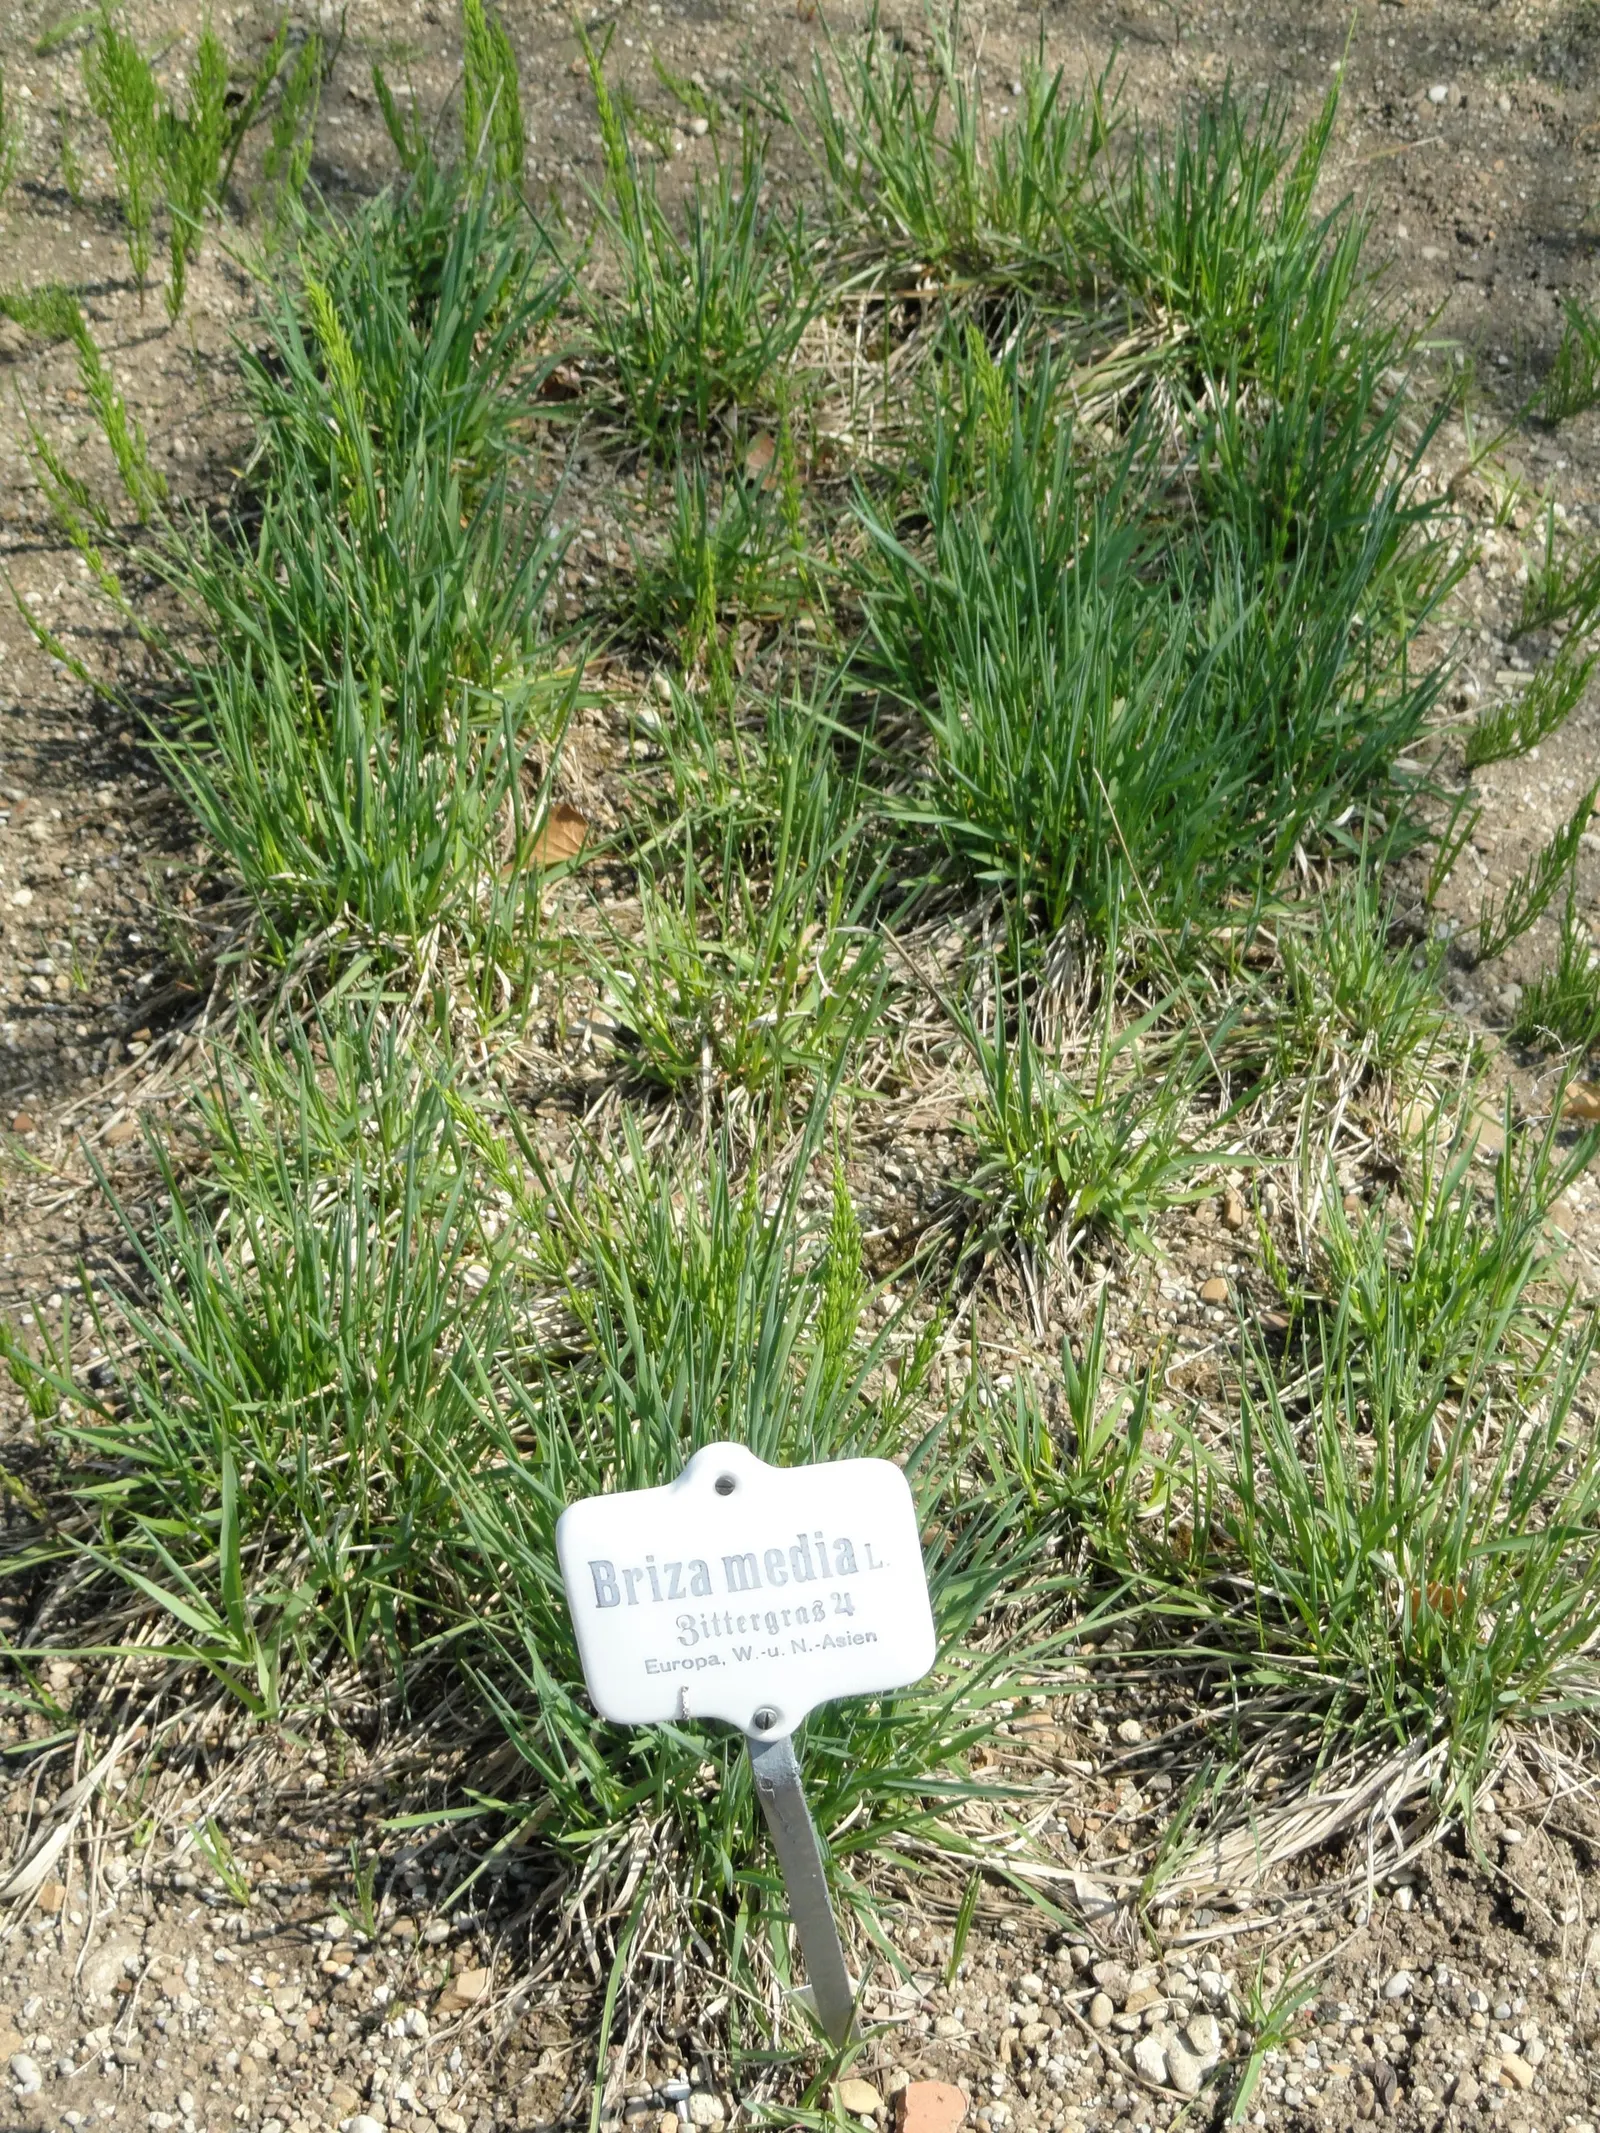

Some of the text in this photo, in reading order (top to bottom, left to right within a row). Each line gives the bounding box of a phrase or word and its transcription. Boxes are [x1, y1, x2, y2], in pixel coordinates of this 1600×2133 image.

[588, 1531, 890, 1608] Briza media L.
[644, 1652, 726, 1675] Europa,
[790, 1630, 878, 1654] N.-Asien
